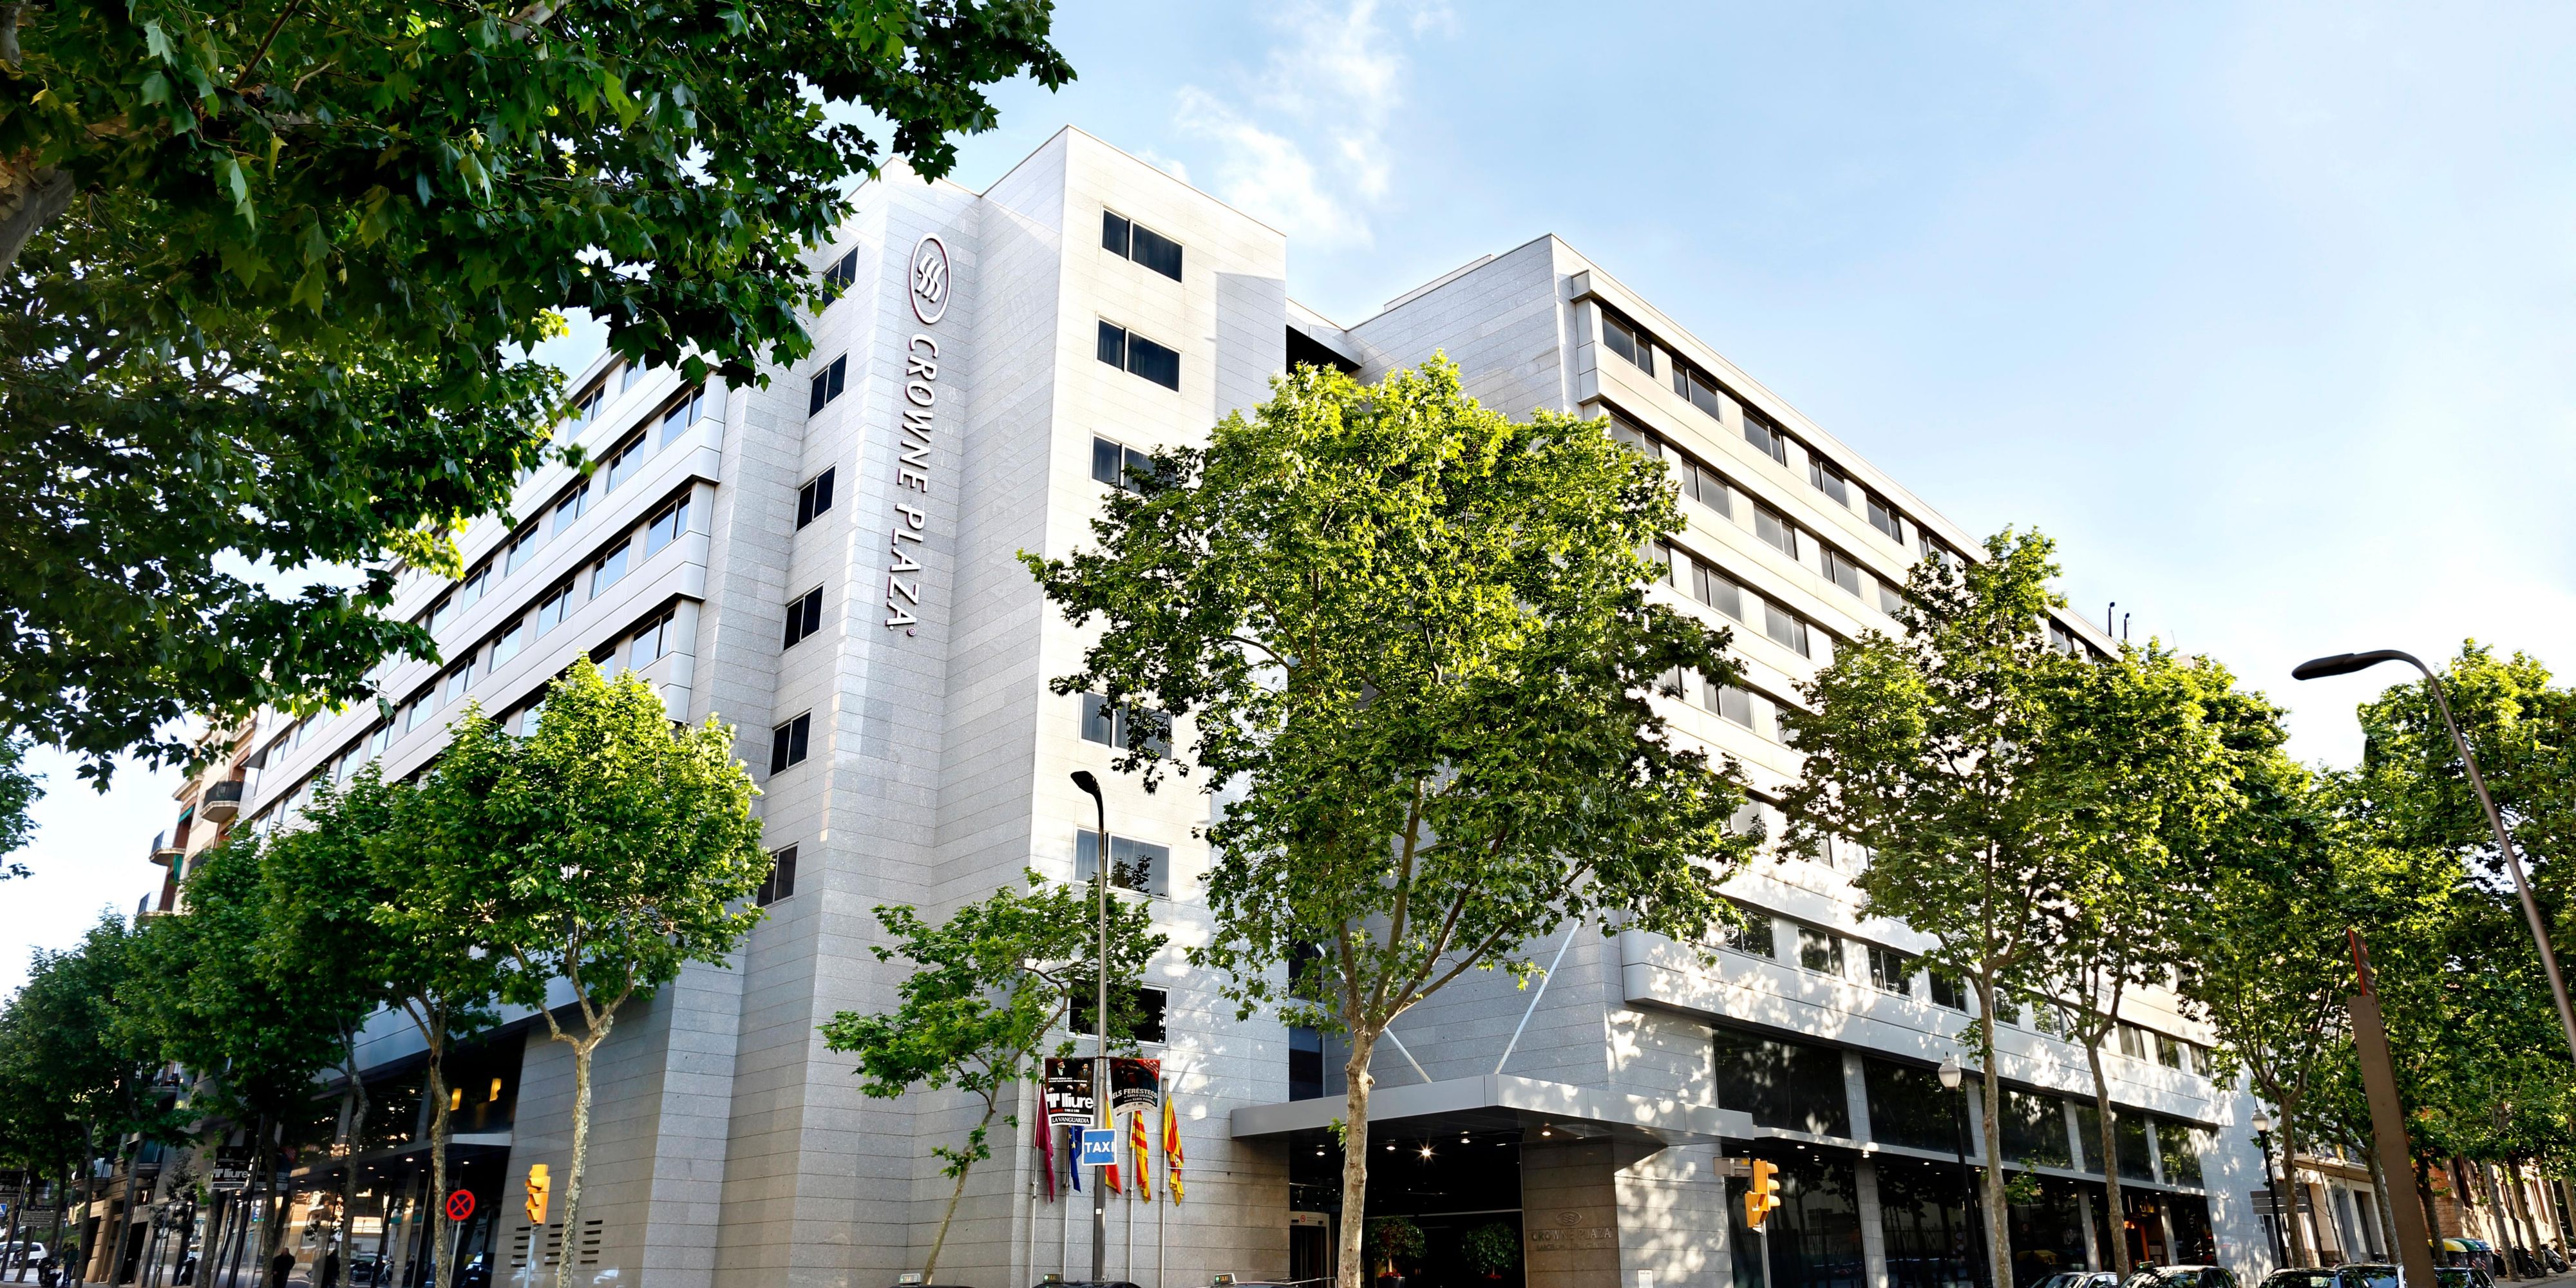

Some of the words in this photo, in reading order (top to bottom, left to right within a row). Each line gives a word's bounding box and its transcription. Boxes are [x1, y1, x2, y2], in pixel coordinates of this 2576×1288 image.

[897, 333, 939, 493] CROWNE
[1113, 1090, 1122, 1099] ELS
[1084, 1141, 1114, 1153] TAXI
[1531, 1228, 1575, 1241] CROWNE
[1578, 1227, 1611, 1240] PLAZA
